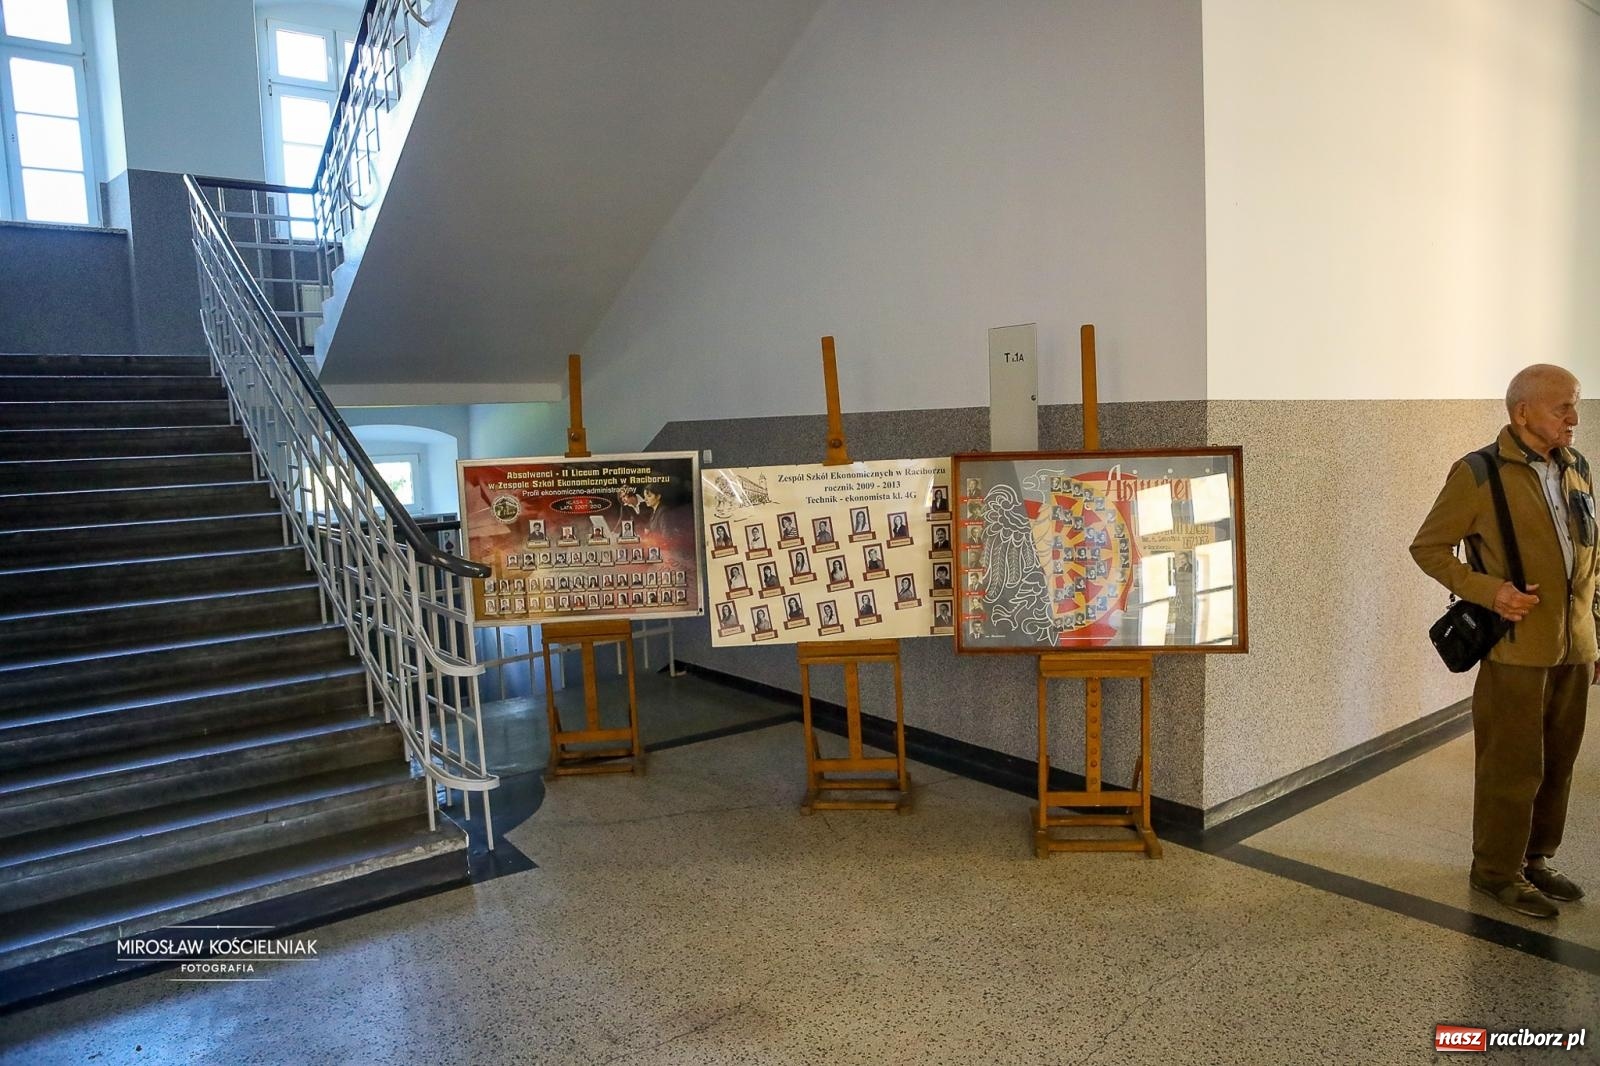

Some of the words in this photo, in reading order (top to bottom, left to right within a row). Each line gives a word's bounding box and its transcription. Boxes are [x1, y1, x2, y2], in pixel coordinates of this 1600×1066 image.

[507, 470, 553, 479] Absolwenci
[571, 468, 600, 477] Liceum
[602, 467, 651, 475] Profilowane
[830, 469, 893, 480] Ekonomicznych
[905, 467, 946, 476] Raciborzu
[498, 481, 529, 489] Zespole
[557, 477, 618, 487] Ekonomicznych
[629, 476, 670, 484] Raciborzu
[824, 483, 854, 492] rocznik
[856, 482, 875, 490] 2009
[883, 481, 901, 489] 2013
[541, 486, 637, 497] ekonomiczno-administracyjny
[806, 495, 838, 504] Technik
[844, 493, 891, 502] ekonomista
